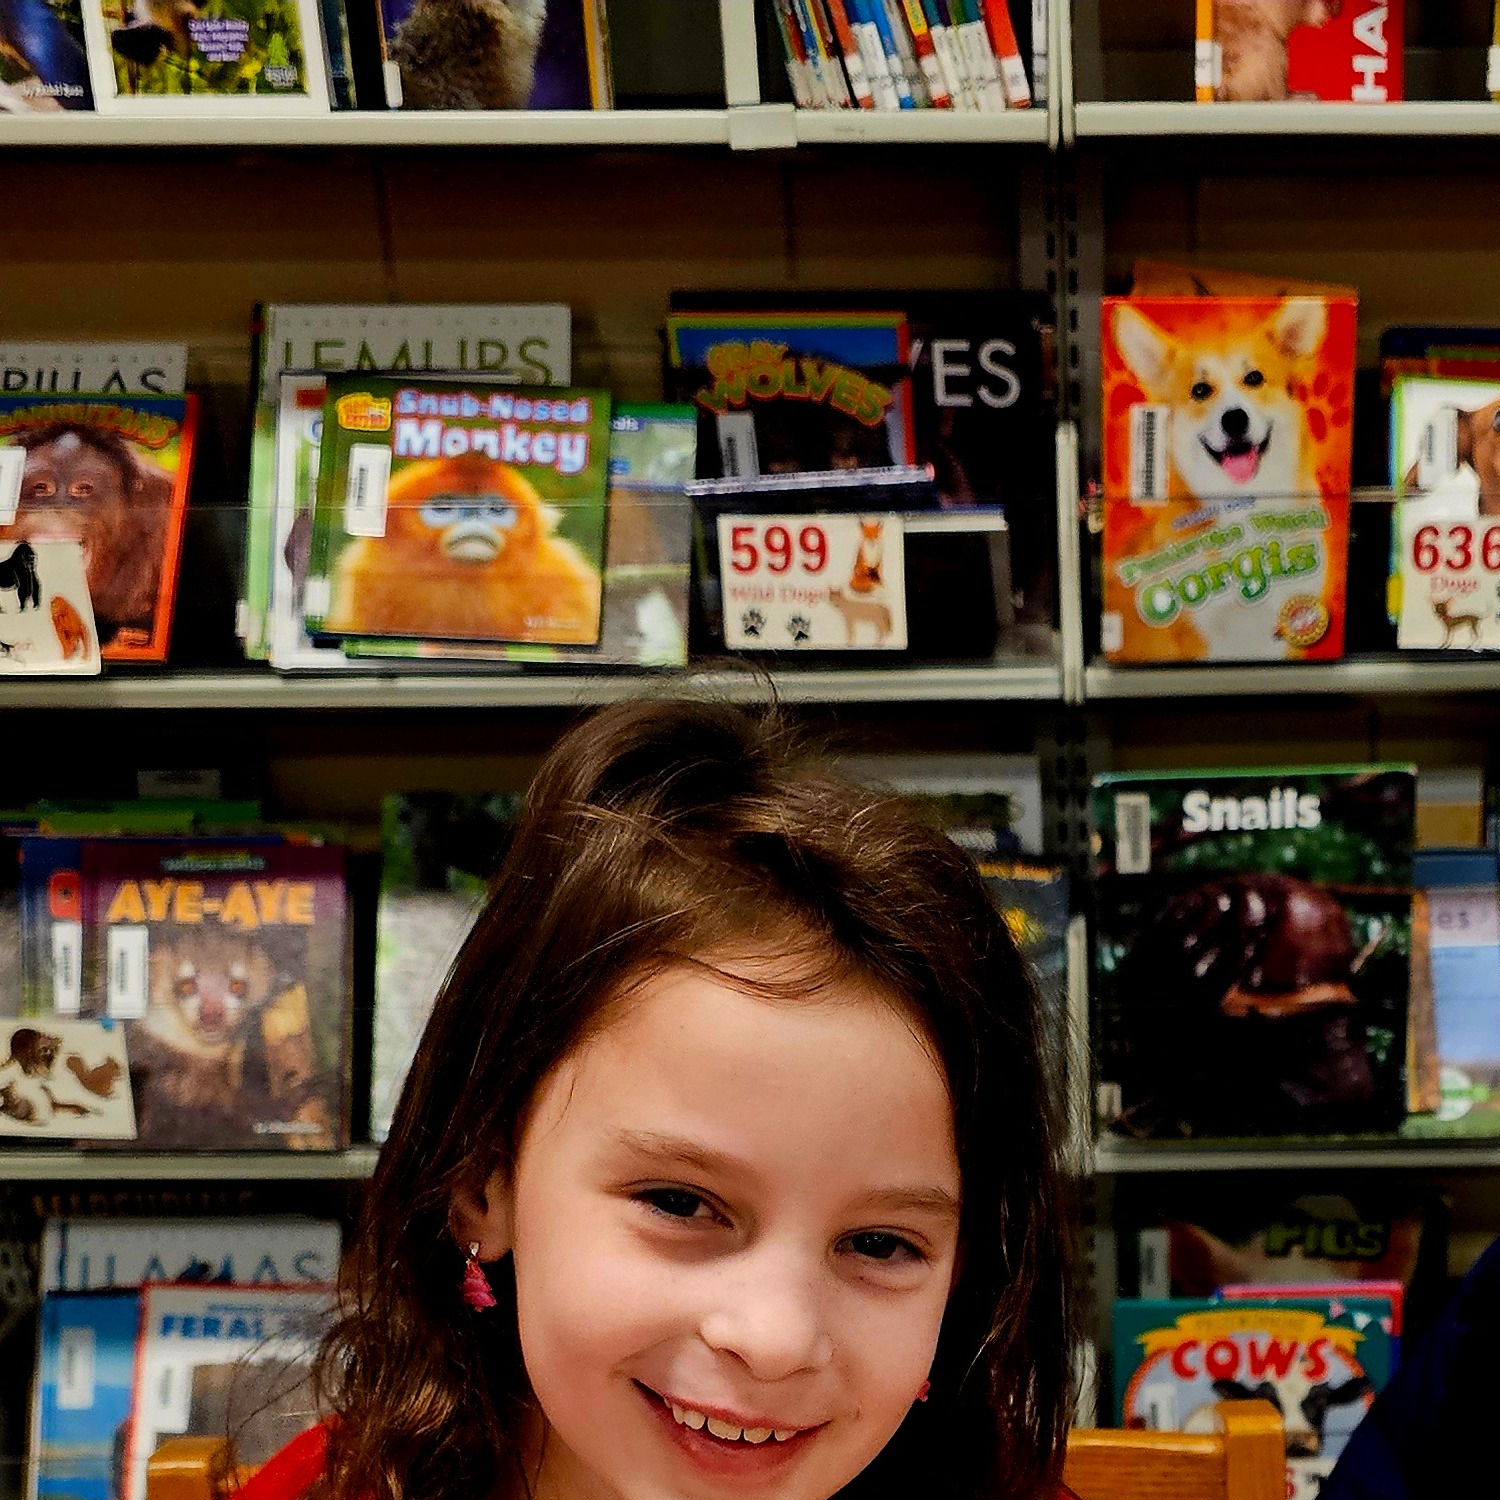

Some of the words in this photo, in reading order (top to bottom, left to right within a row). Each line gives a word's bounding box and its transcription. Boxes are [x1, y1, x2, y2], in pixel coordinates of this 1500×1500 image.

[396, 390, 591, 424] Snub-Nosed
[696, 357, 893, 427] WOLVES
[394, 418, 590, 475] Monkey
[730, 525, 829, 574] 599
[1139, 540, 1318, 622] Corgis
[1182, 787, 1321, 833] Snails
[106, 878, 316, 929] AYE-AYE
[1172, 1338, 1329, 1381] COWS
